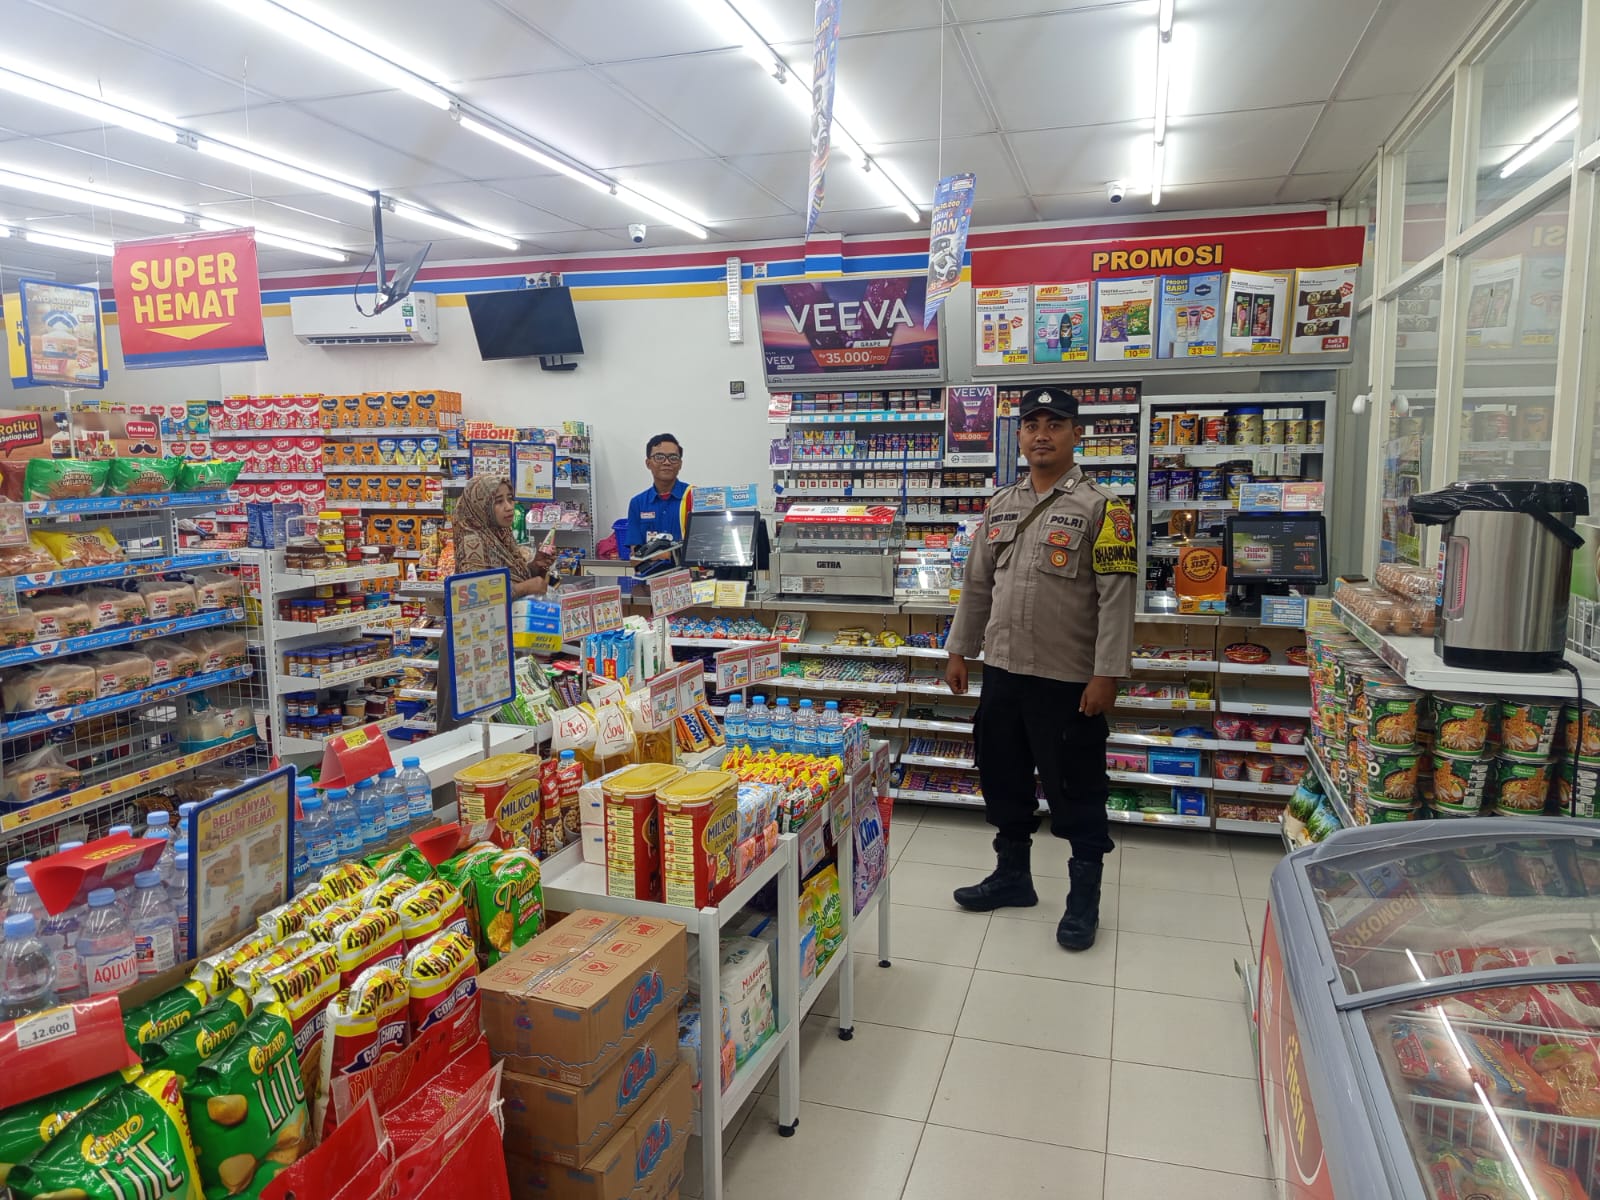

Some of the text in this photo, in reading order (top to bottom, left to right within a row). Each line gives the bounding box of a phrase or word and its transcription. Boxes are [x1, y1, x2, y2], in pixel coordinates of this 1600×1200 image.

[1092, 245, 1223, 272] PROMOSI
[130, 252, 238, 292] SUPER
[133, 288, 239, 324] HEMAT
[784, 298, 914, 333] VEEVA
[766, 356, 795, 365] VEEV
[953, 388, 992, 397] VEEVA
[0, 421, 37, 434] Rotiku
[23, 431, 38, 439] Hari
[467, 422, 493, 430] TEBUS
[467, 429, 515, 440] HEBOH!
[1050, 515, 1083, 528] POLRI
[816, 561, 841, 569] GETRA
[212, 813, 233, 830] BELI
[233, 794, 272, 821] BANYAK
[219, 804, 277, 843] LEBIH HEMAT
[434, 1000, 456, 1019] CORN
[32, 1022, 70, 1040] 12.600
[295, 1022, 315, 1046] CORN
[380, 1024, 404, 1043] CHIPS
